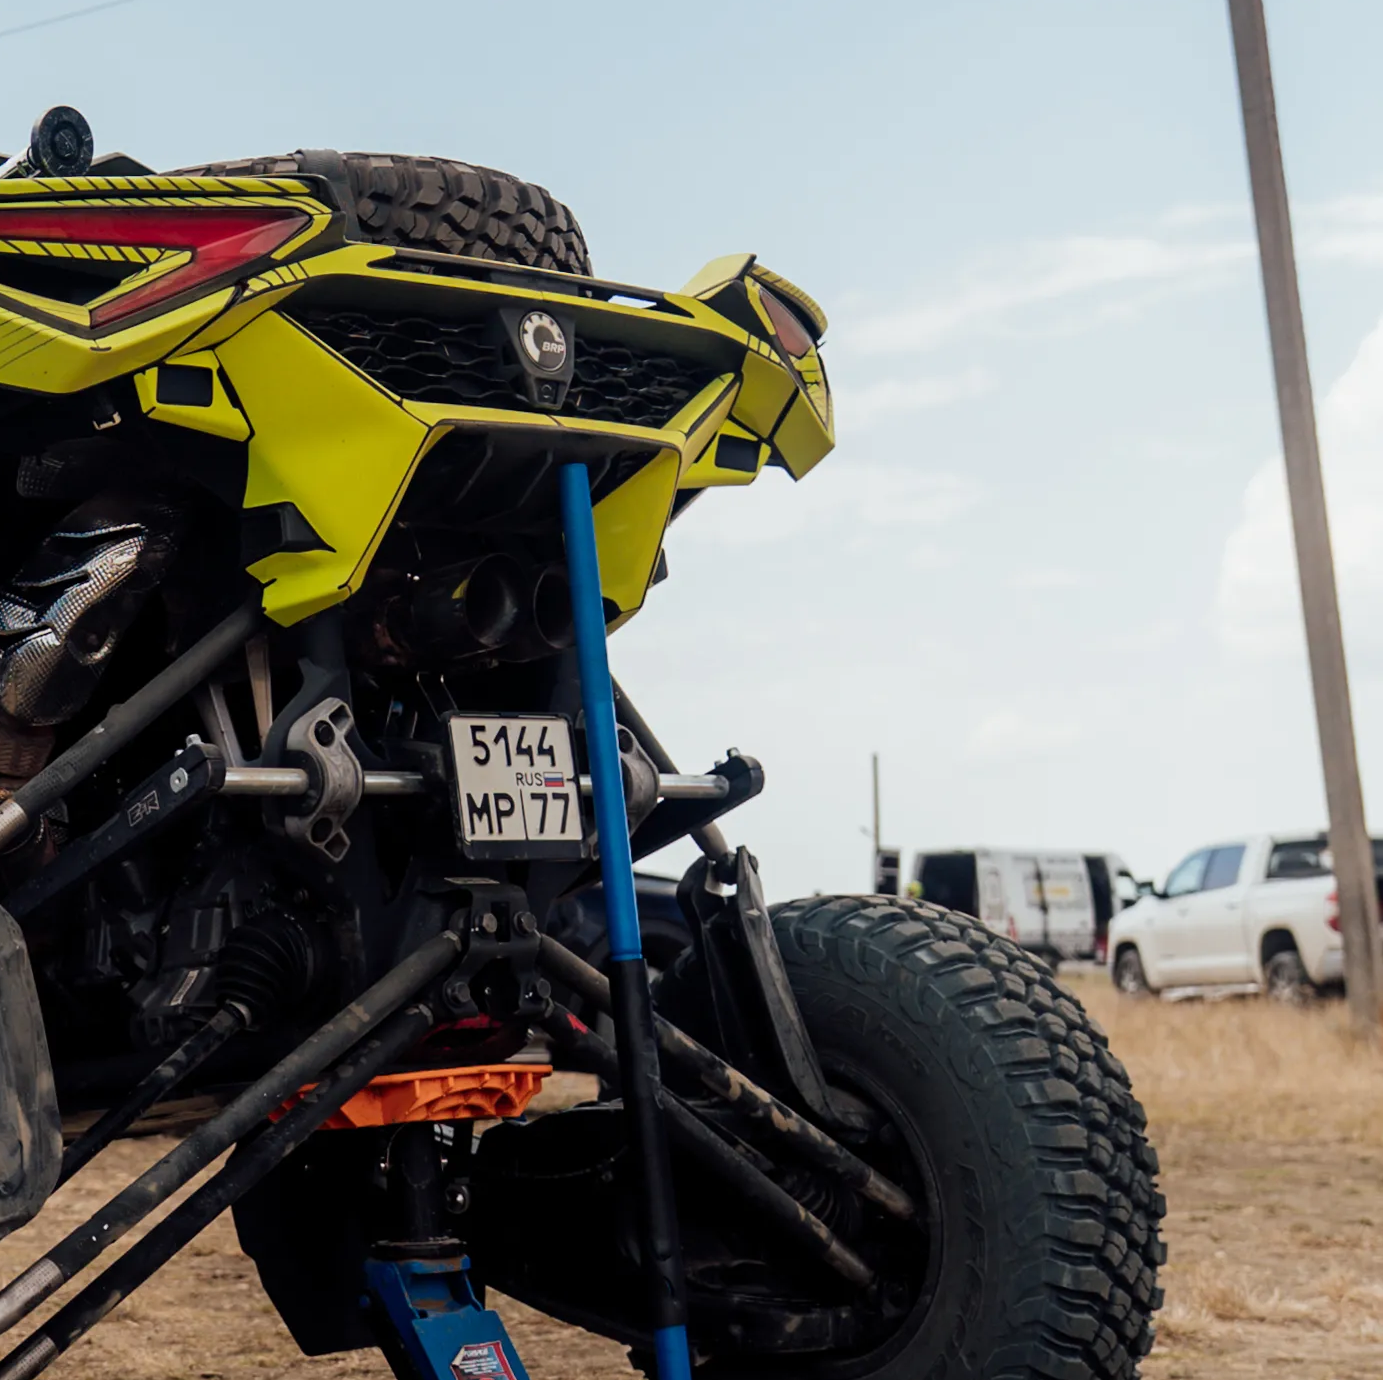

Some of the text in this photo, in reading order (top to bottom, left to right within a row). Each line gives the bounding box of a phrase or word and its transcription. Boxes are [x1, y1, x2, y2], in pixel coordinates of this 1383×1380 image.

[542, 341, 565, 354] BRP
[469, 725, 556, 767] 5144
[516, 772, 543, 787] RUS
[531, 792, 570, 835] 77
